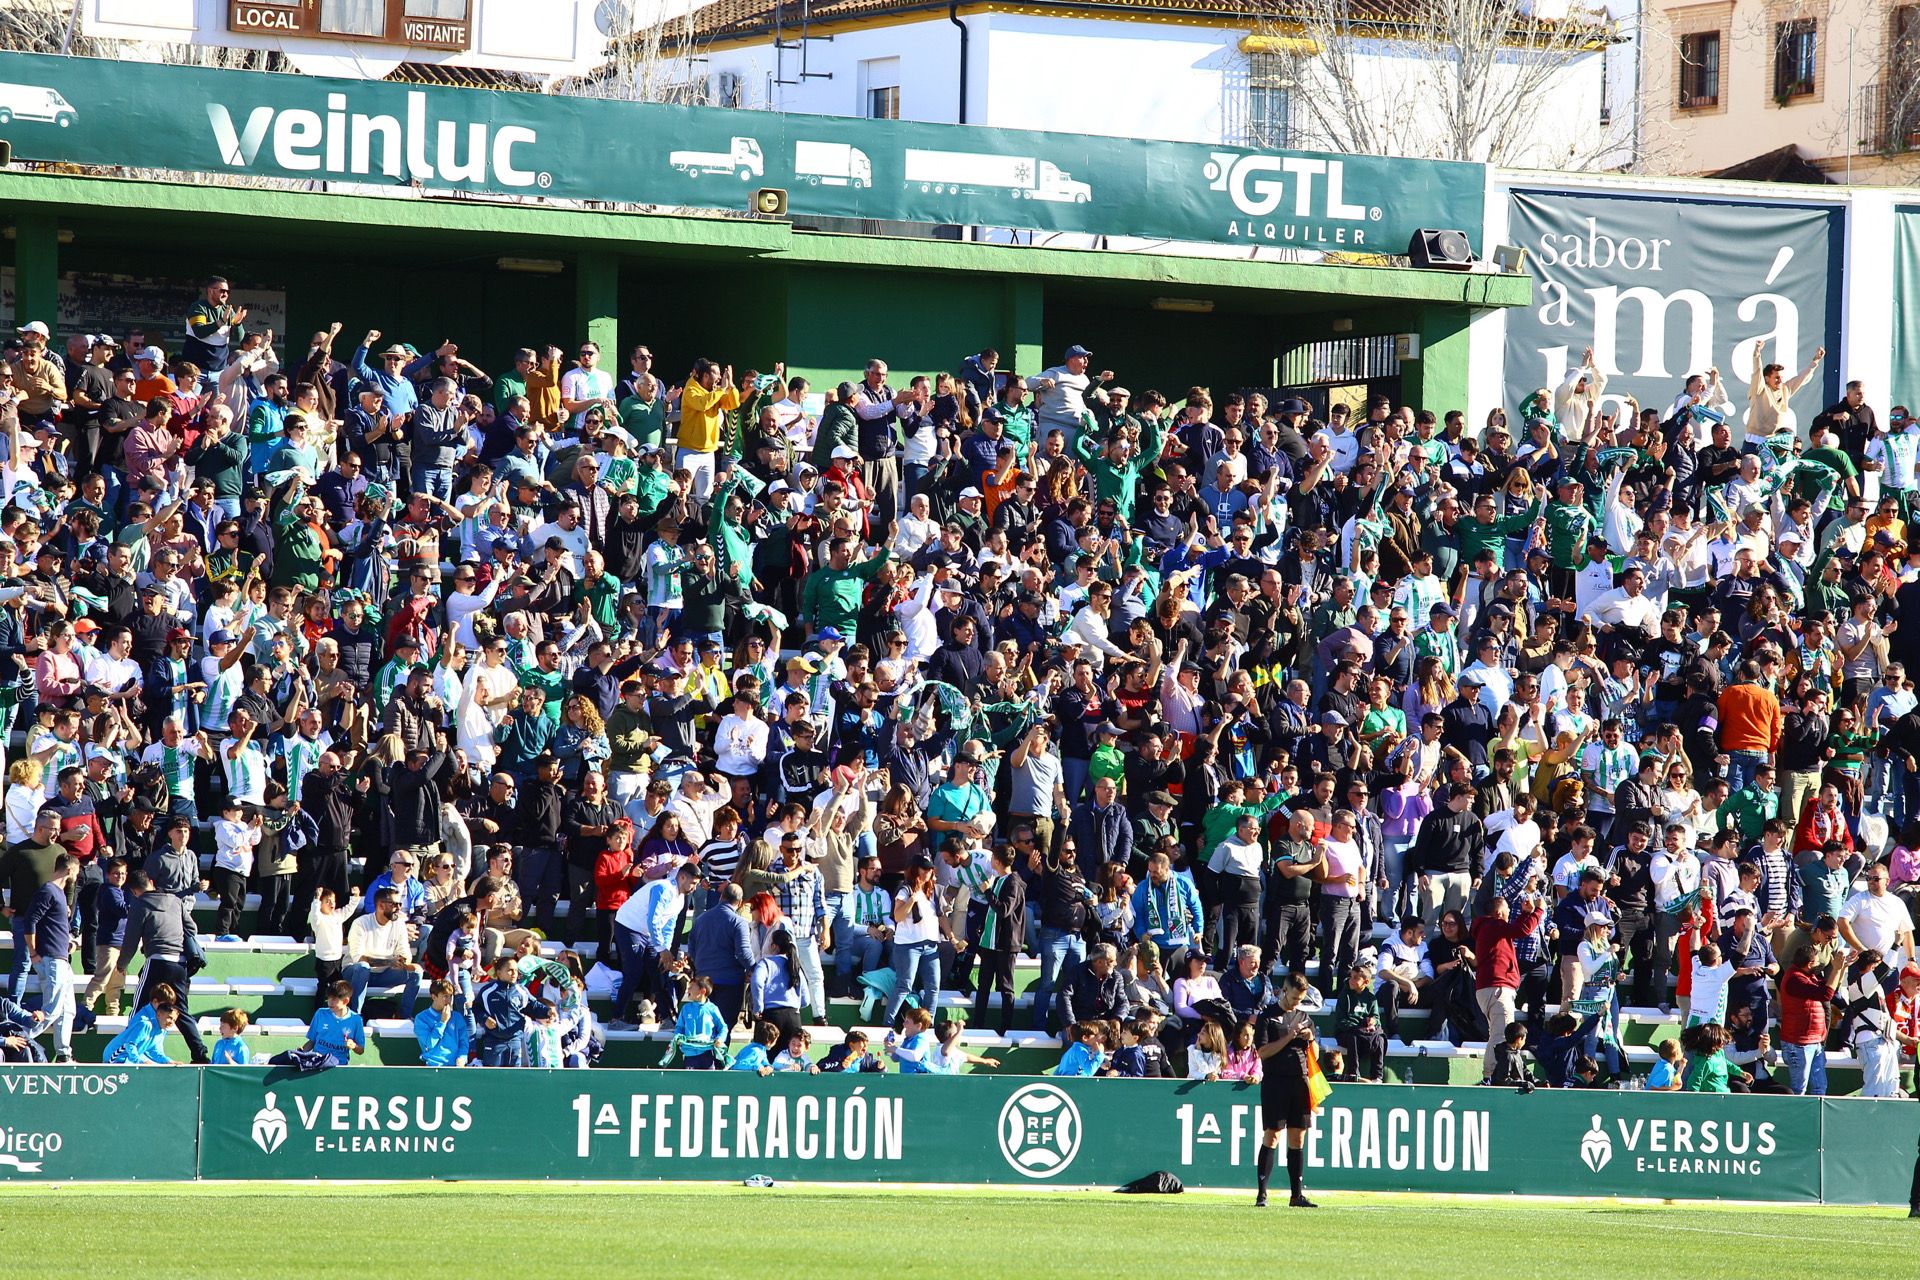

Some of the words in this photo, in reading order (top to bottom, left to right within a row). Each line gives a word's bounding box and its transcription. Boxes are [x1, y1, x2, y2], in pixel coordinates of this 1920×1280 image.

[236, 8, 299, 30] LOCAL
[404, 22, 465, 44] VISITANTE
[1227, 220, 1366, 247] ALQUILER
[1539, 217, 1671, 271] sabor
[1538, 281, 1575, 327] a
[1584, 247, 1799, 385] má
[294, 1095, 472, 1132] VERSUS
[629, 1086, 903, 1161] FEDERACIÓN
[1027, 1116, 1054, 1129] RF
[315, 1136, 455, 1153] E-LEARNING
[1027, 1132, 1054, 1145] EF
[1617, 1118, 1777, 1157] VERSUS
[1637, 1157, 1762, 1177] E-LEARNING
